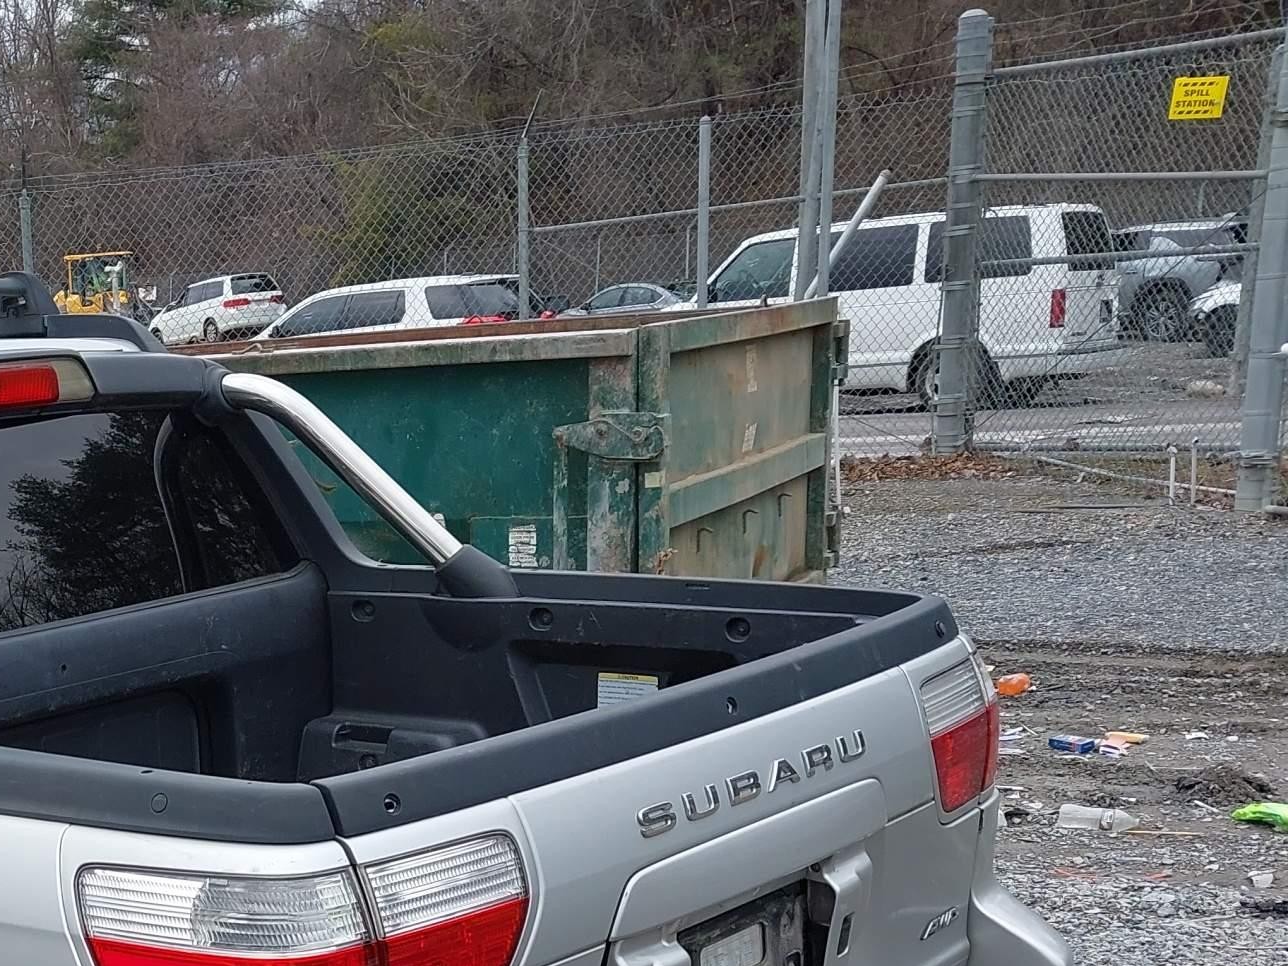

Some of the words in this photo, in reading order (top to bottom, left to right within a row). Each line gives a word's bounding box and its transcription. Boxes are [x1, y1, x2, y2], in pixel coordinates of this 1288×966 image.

[1184, 89, 1210, 98] SPILL
[1175, 99, 1216, 108] STATION
[636, 729, 867, 839] SUBARU
